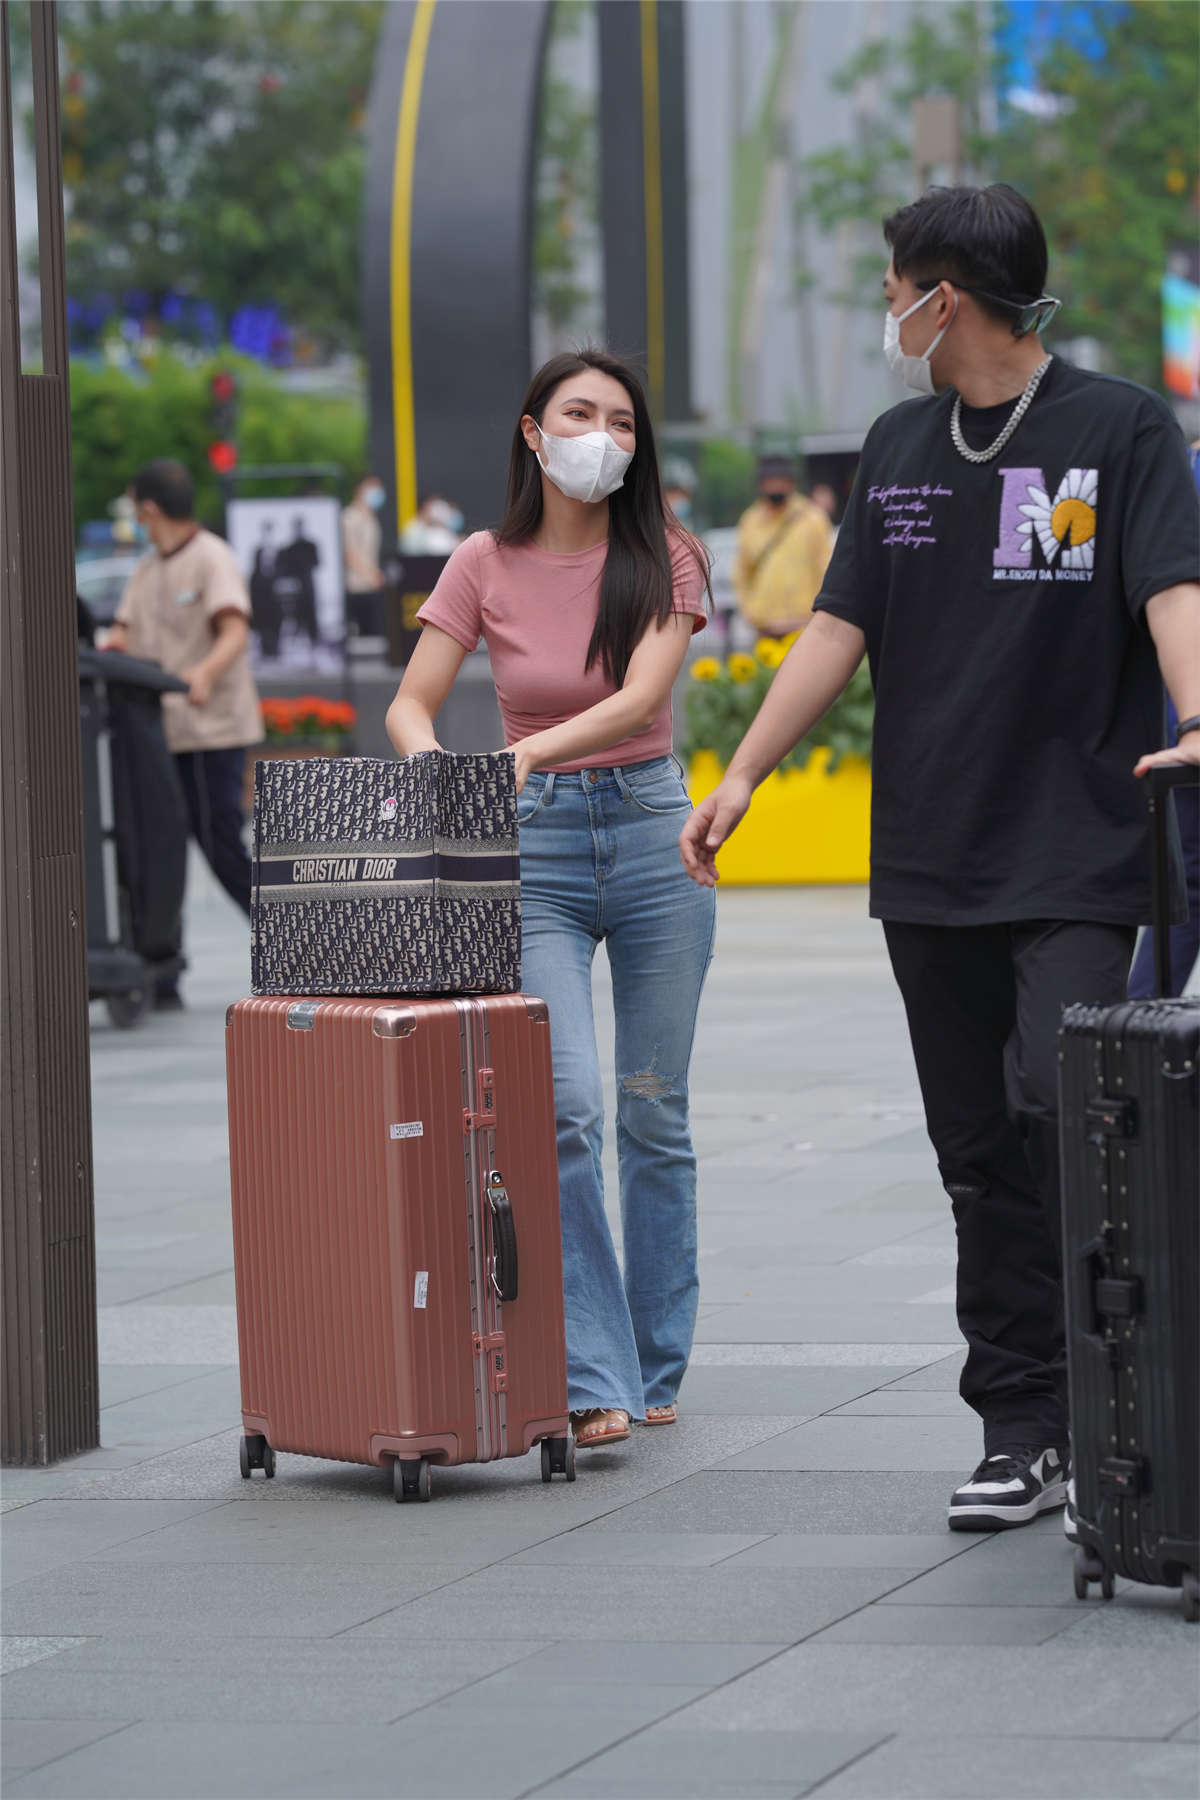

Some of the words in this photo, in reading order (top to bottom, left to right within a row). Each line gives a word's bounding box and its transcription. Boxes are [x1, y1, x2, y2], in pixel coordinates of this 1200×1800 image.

[1055, 568, 1094, 582] MONEY
[292, 859, 360, 882] CHRISTIAN
[361, 858, 398, 880] DIOR
